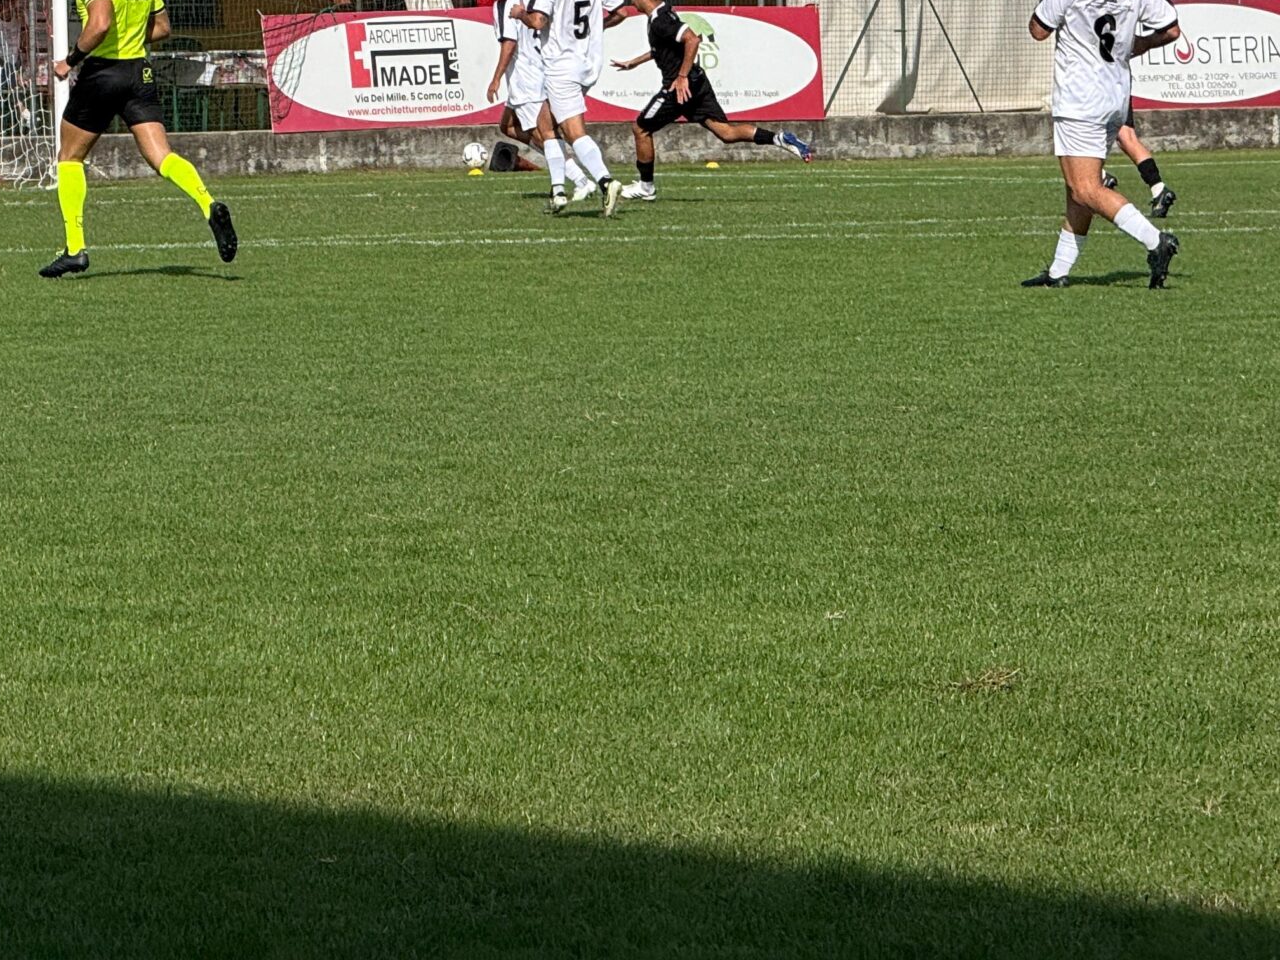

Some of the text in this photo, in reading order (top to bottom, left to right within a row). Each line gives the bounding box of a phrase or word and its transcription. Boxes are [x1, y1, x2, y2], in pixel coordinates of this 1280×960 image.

[574, 0, 591, 40] 5
[369, 27, 451, 44] ARCHITETTURE
[1094, 14, 1116, 62] 6
[448, 49, 461, 84] LAB
[380, 65, 442, 87] MADE
[1204, 72, 1229, 81] 21029
[1238, 72, 1278, 80] VERGIATE
[354, 93, 369, 103] Via
[371, 93, 385, 102] Dei
[410, 92, 416, 101] 5
[417, 91, 443, 101] Como
[444, 88, 465, 102] (CO)
[1160, 89, 1245, 98] WWW.ALLOSTERIA.IT
[347, 102, 474, 117] www.architetturemadelab.ch
